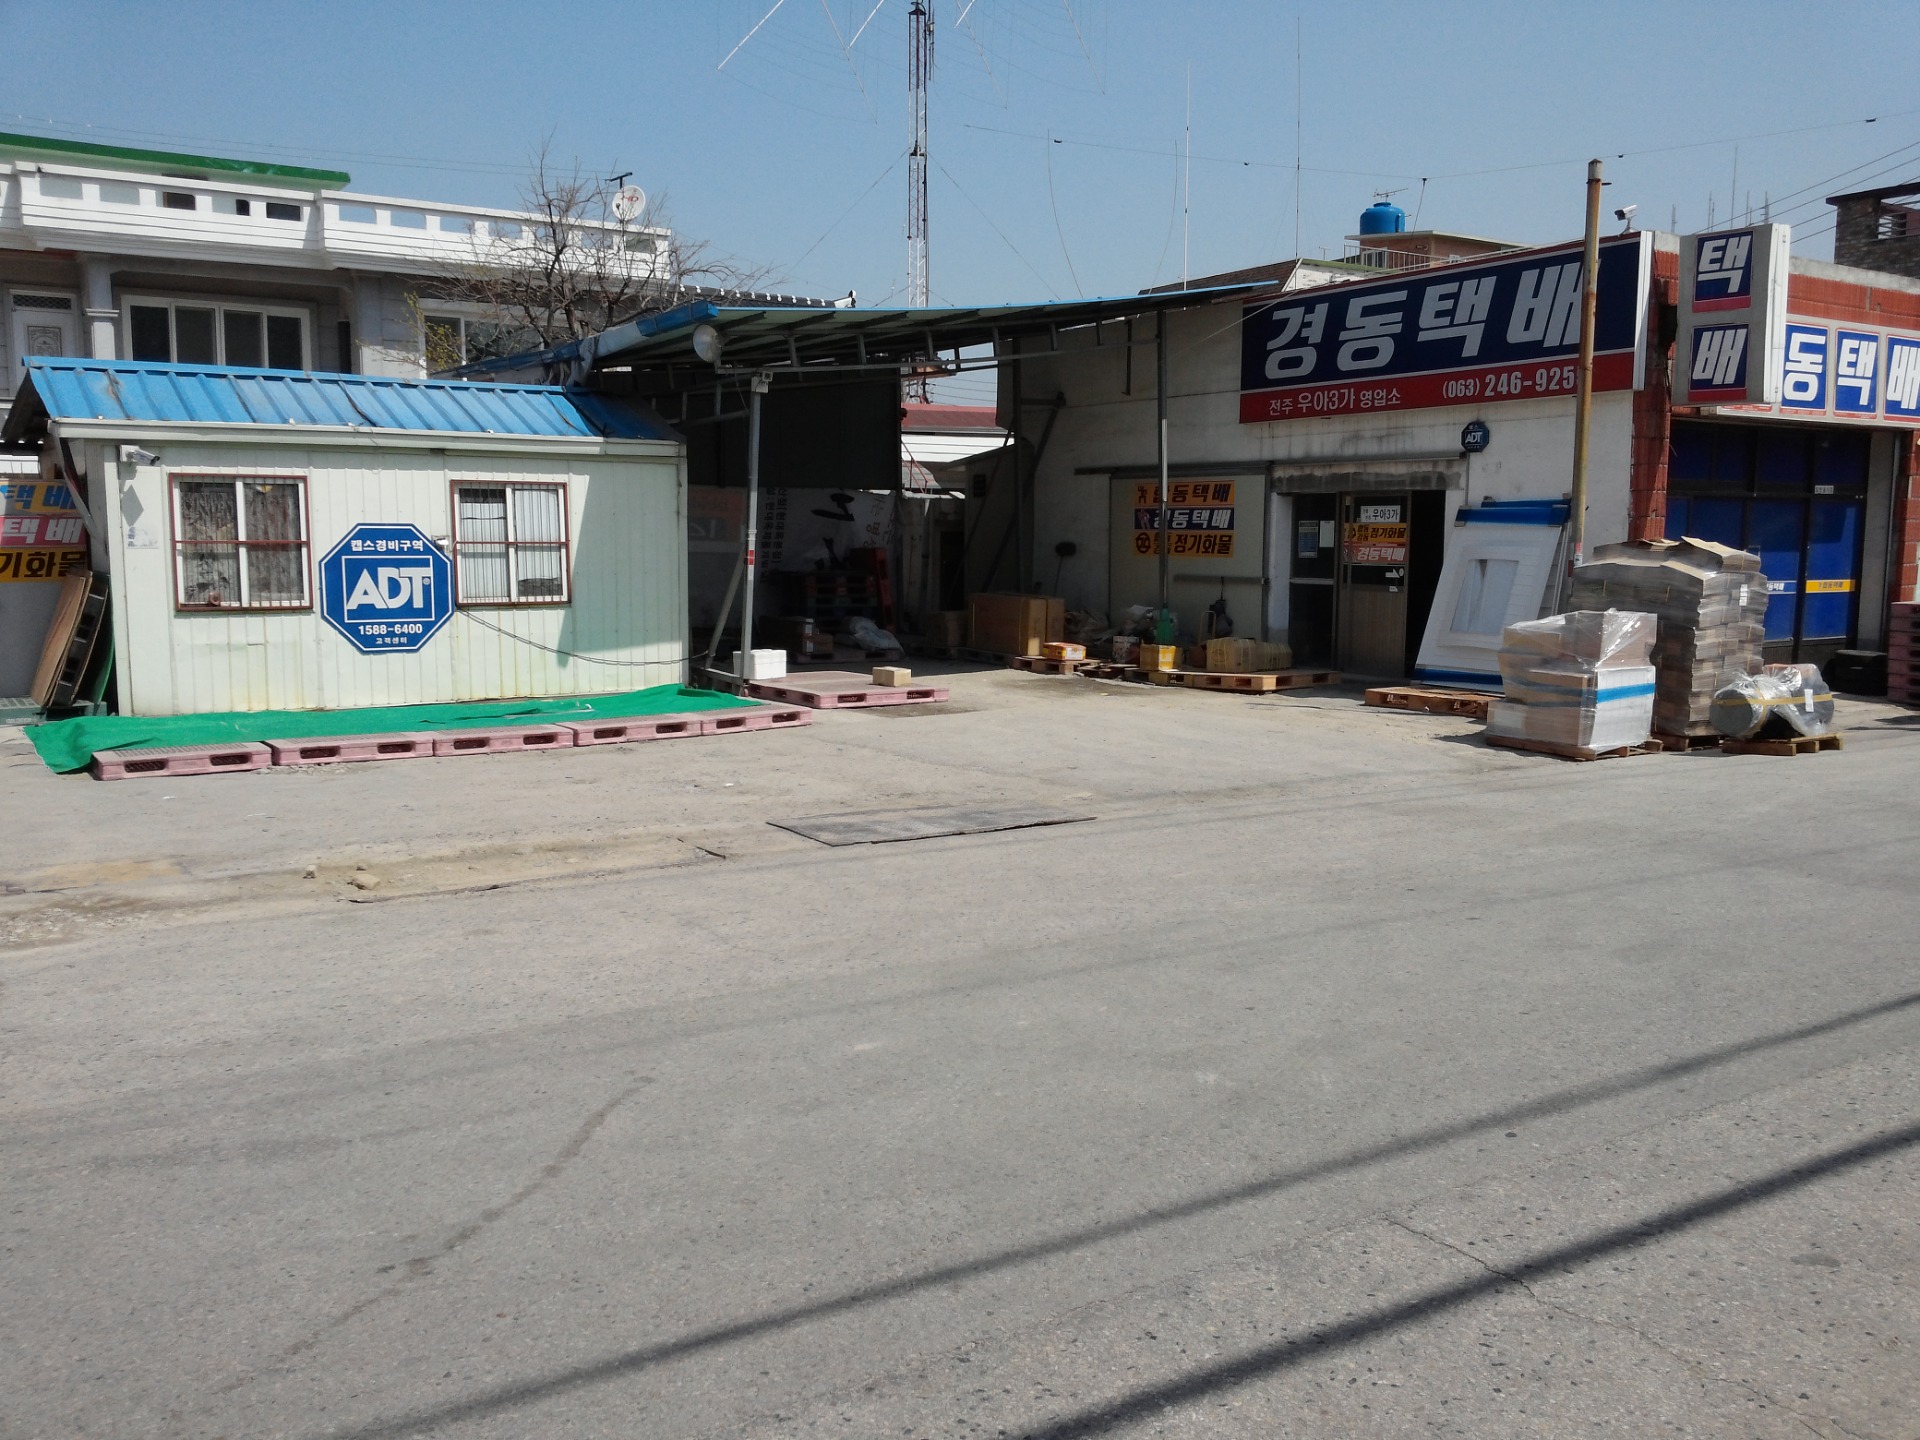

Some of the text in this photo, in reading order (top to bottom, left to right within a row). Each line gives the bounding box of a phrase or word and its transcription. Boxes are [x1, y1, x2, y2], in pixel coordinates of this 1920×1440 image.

[1264, 258, 1601, 380] 경동택배
[1269, 365, 1578, 416] 전주 우아3가 영업소 (063) 246-925
[1465, 431, 1483, 443] ADT
[1372, 508, 1398, 521] 우아3가
[3, 518, 84, 544] 택배
[1370, 527, 1407, 539] 정기화물
[350, 539, 424, 552] 캡스경비구역
[1174, 534, 1233, 555] 정기화물
[1357, 547, 1406, 561] 경동택배
[346, 566, 432, 610] ADT
[358, 623, 423, 635] 1588-6400
